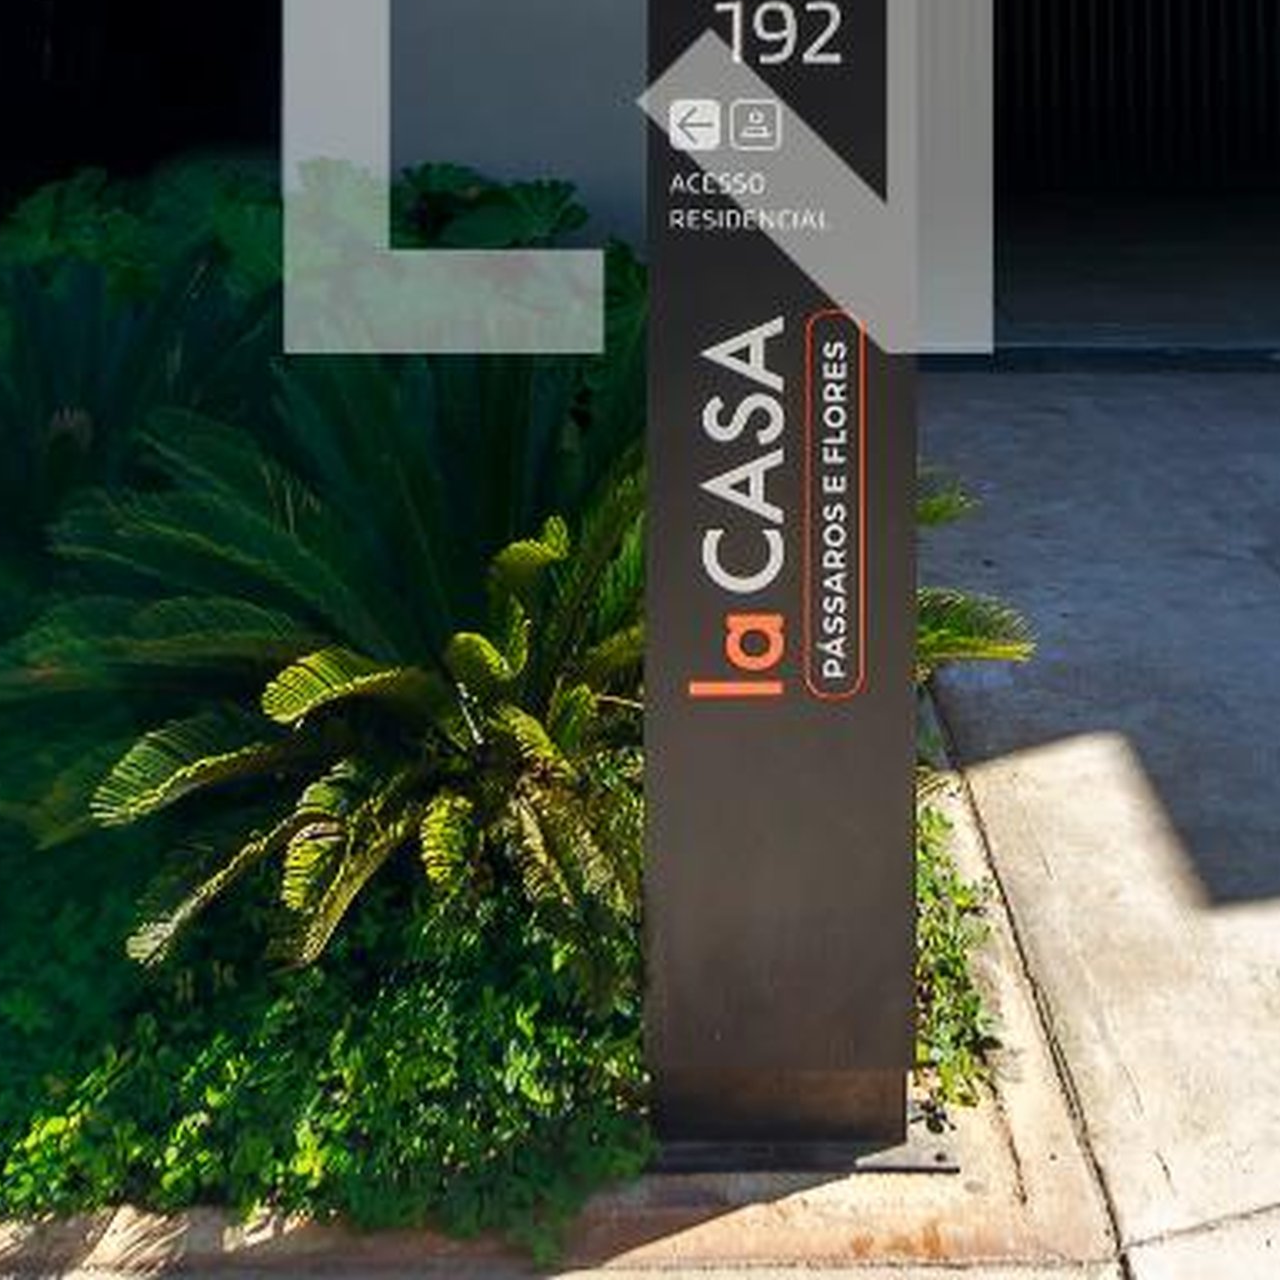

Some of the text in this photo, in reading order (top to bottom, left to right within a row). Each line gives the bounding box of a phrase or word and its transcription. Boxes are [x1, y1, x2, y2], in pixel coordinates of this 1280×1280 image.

[714, 0, 843, 65] 192
[669, 171, 766, 195] ACESSO
[669, 208, 828, 231] RESIDENCIAL
[818, 340, 848, 679] PÁSSAROS E FLORES
